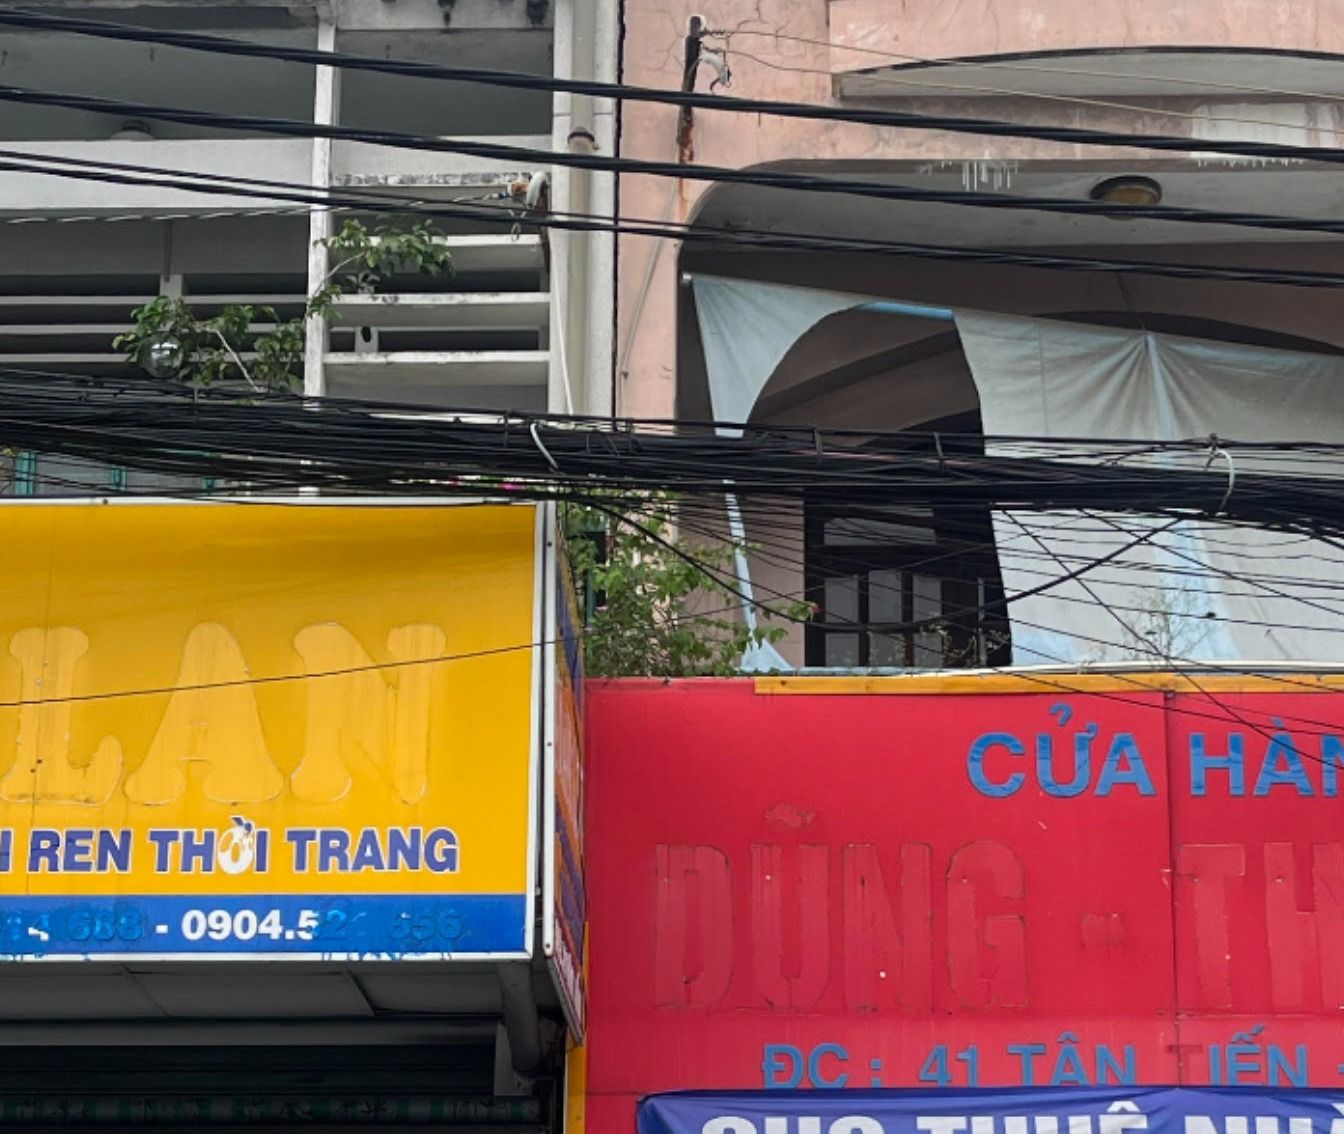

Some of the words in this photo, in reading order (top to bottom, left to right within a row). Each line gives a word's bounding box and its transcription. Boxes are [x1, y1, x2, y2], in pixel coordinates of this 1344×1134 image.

[966, 703, 1157, 799] CỬA
[26, 828, 133, 874] REN
[150, 816, 269, 876] THỜI
[286, 828, 461, 875] TRANG
[918, 1044, 980, 1089] 41
[1008, 1032, 1137, 1088] TÂN
